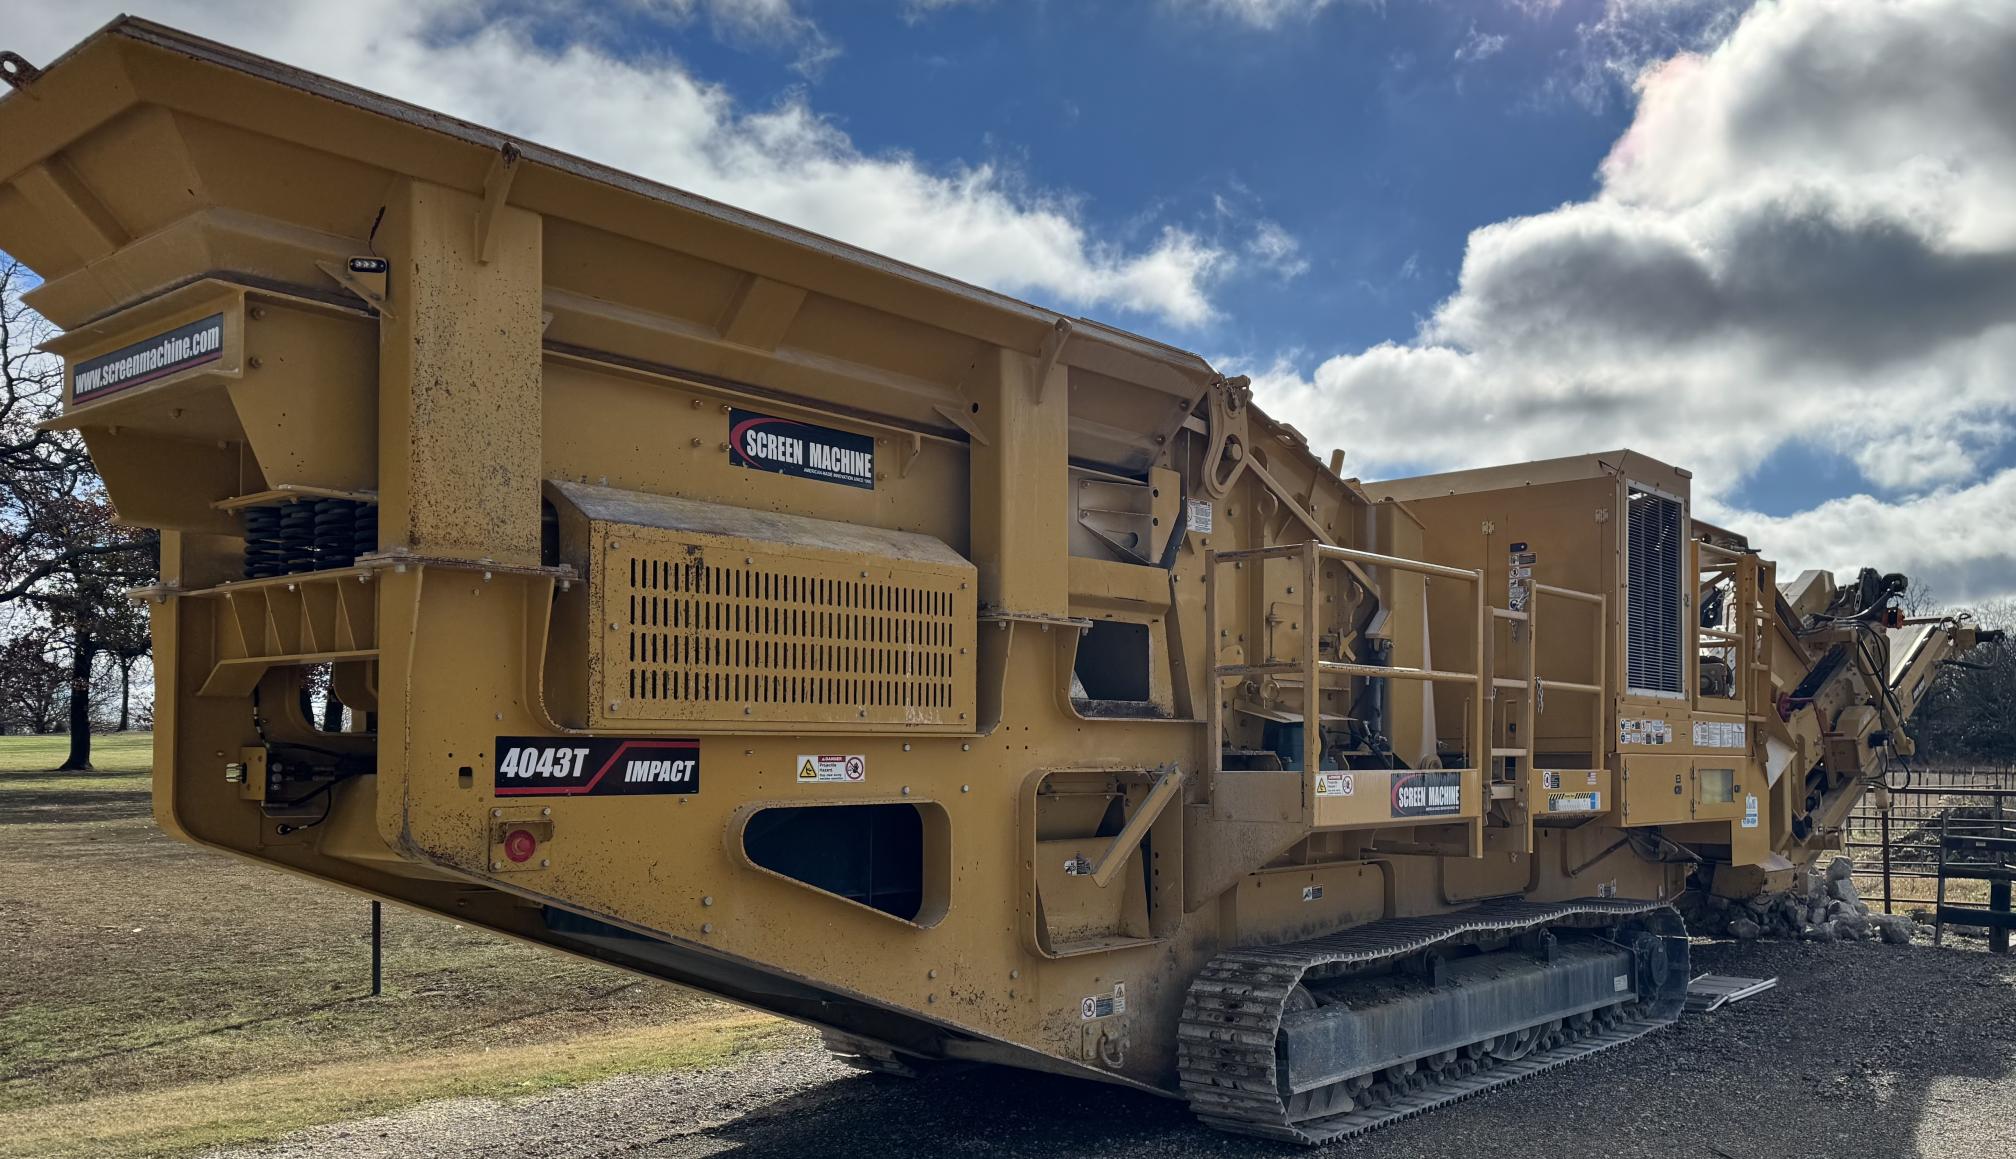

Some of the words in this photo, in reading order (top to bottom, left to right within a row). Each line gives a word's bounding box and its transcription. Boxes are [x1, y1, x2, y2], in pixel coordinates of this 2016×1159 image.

[75, 326, 219, 394] www.screenmachine.com
[746, 429, 803, 466] SCREEN
[809, 442, 873, 478] MACHINE
[500, 747, 590, 777] 4043T
[624, 760, 696, 783] IMPACT
[1398, 787, 1425, 808] SCREEN
[1428, 785, 1460, 806] MACHINE
